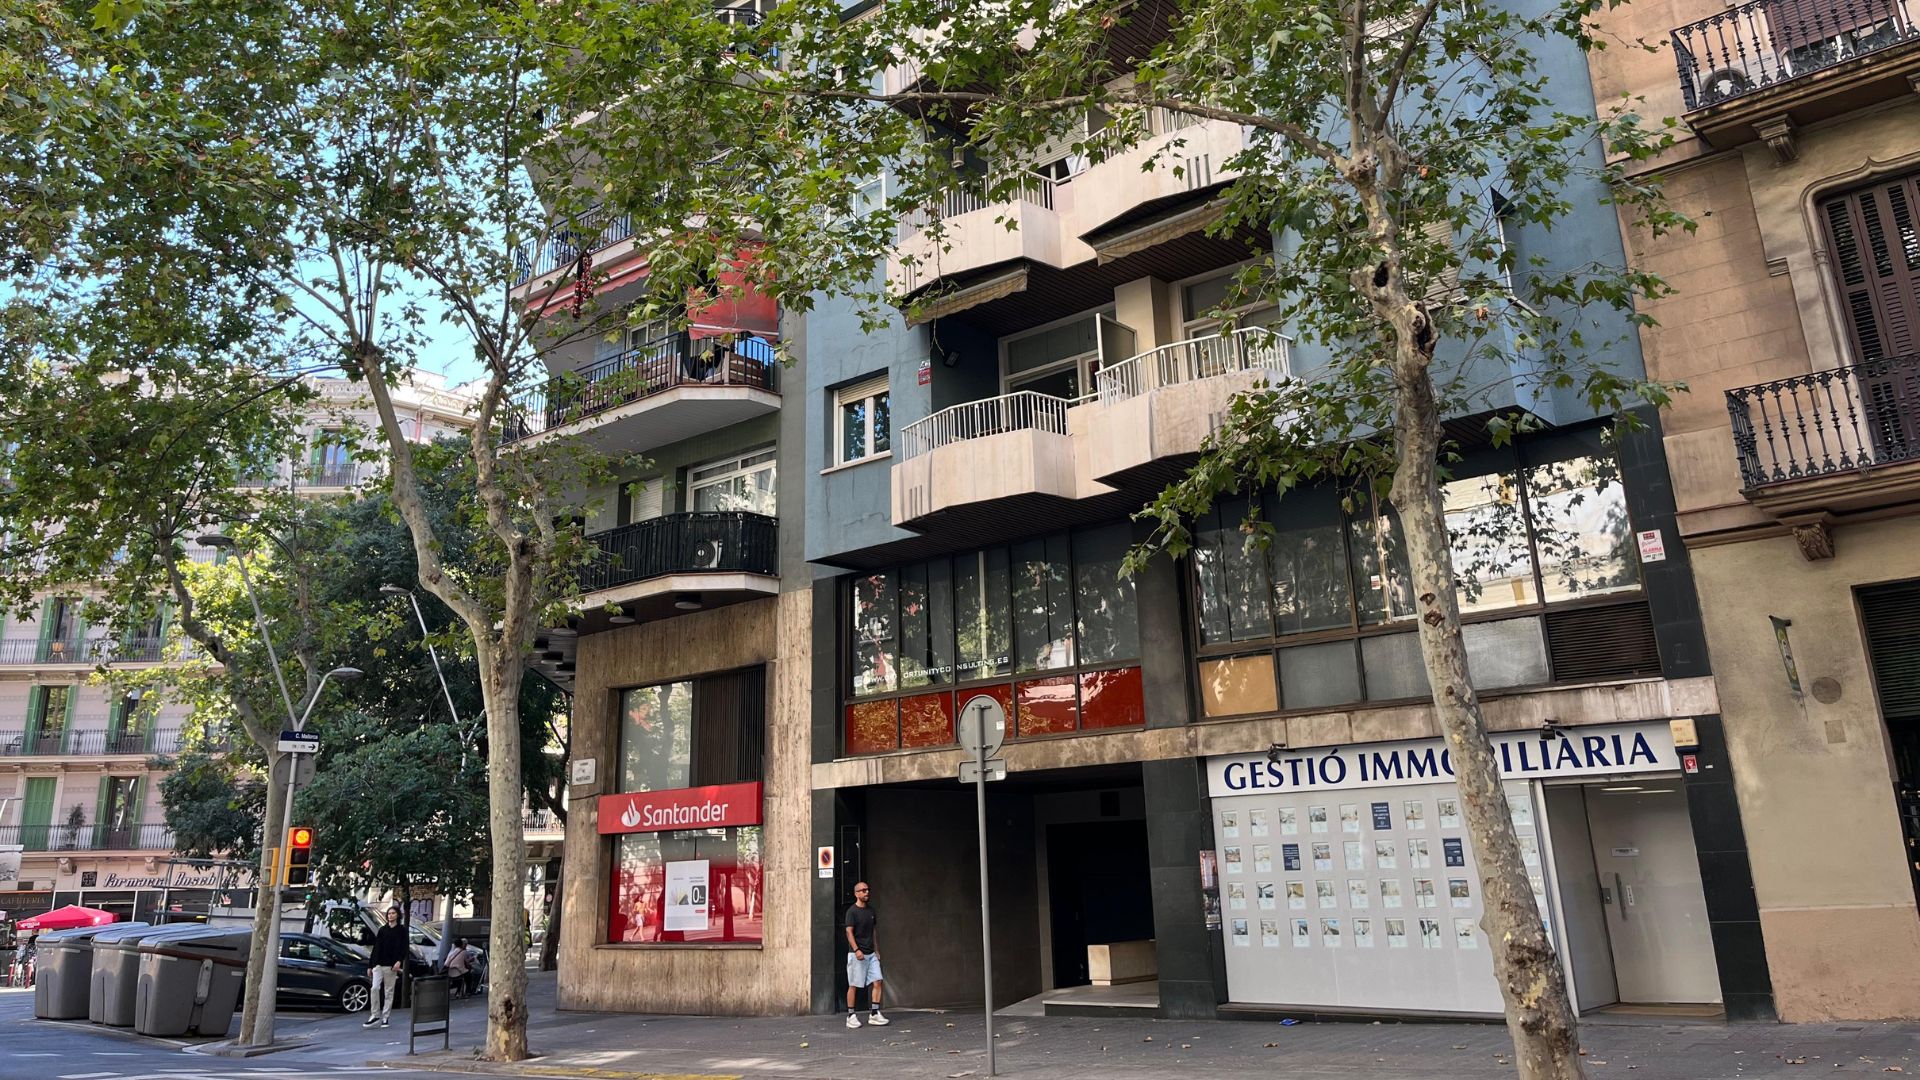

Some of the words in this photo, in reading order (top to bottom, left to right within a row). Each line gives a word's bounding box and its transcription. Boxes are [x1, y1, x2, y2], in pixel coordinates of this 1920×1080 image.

[1224, 749, 1348, 791] GESTIÓ
[1359, 731, 1659, 782] IMMILIÀRIA
[643, 800, 728, 827] Santander
[174, 871, 216, 887] Bosch
